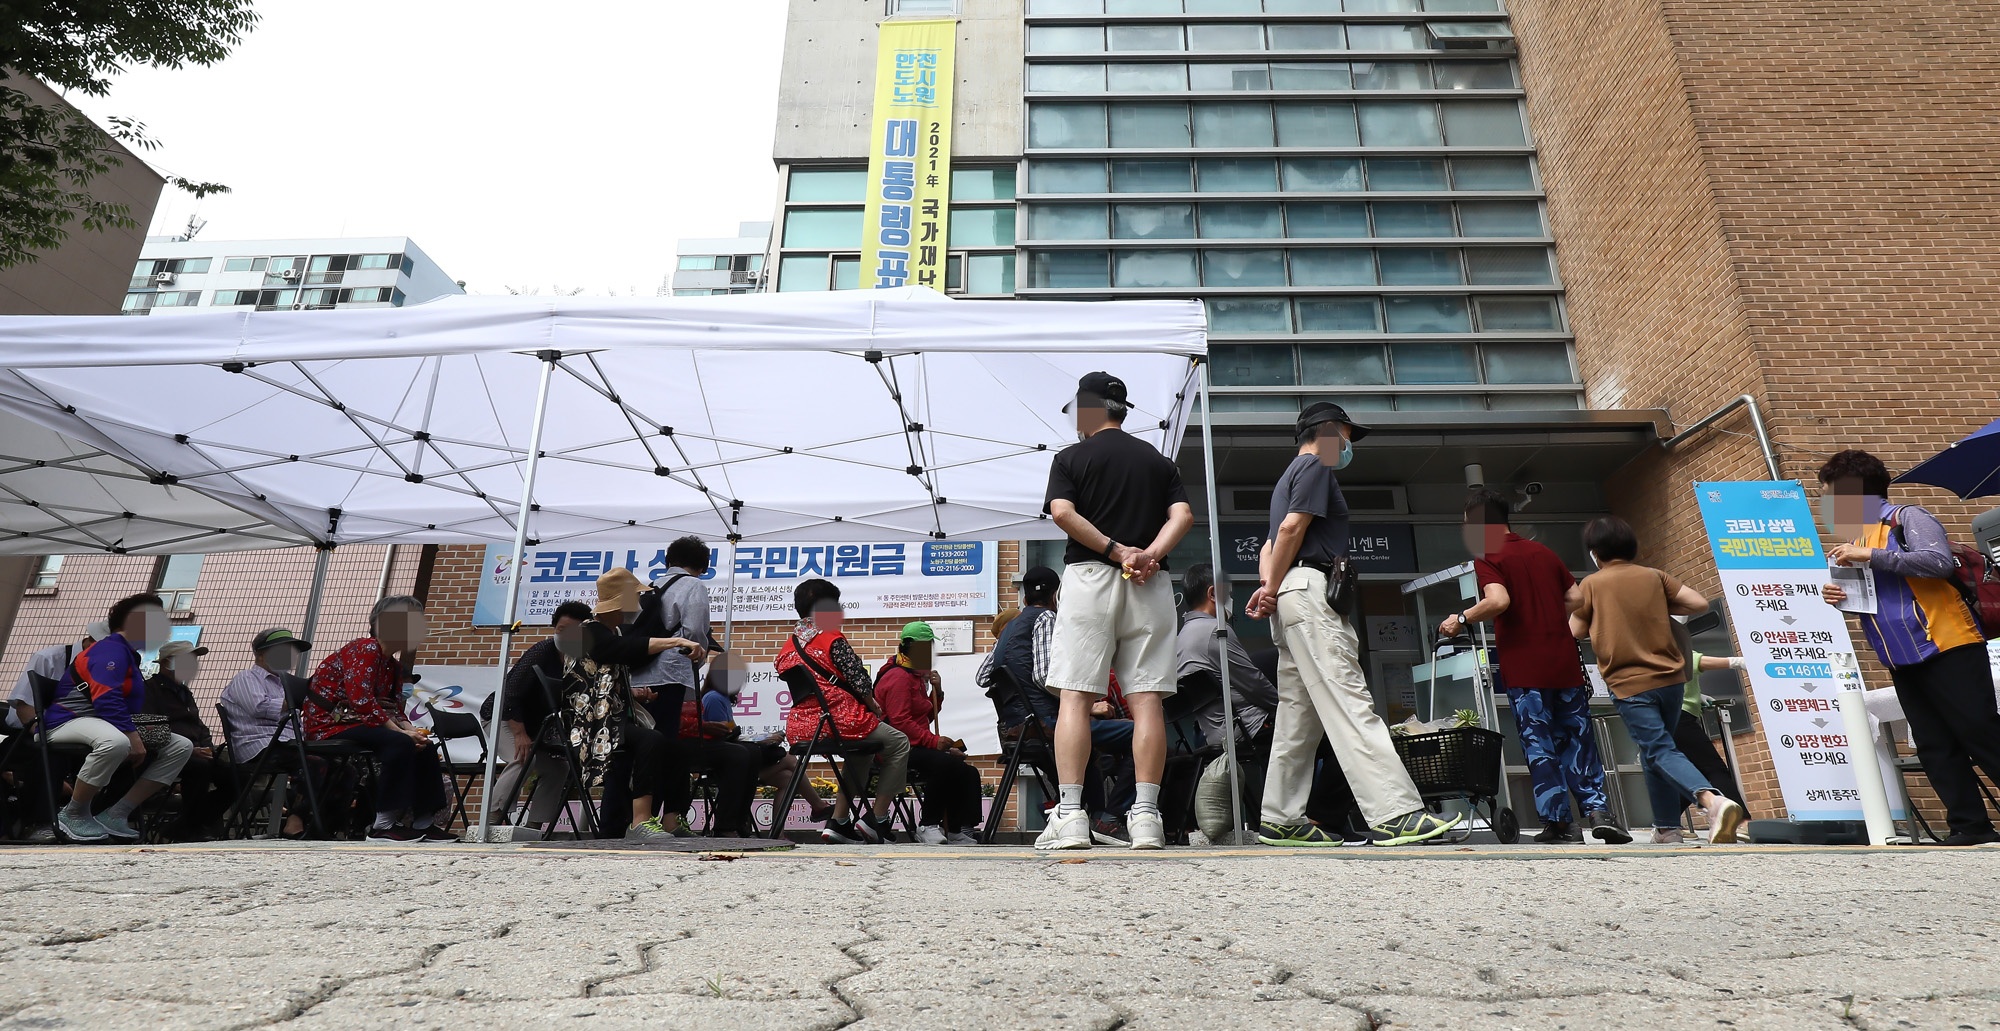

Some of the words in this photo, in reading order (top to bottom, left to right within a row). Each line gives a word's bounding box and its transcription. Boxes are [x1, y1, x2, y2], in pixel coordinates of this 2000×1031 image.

[1724, 519, 1766, 534] 코로나
[1767, 518, 1796, 533] 상생
[1718, 537, 1815, 557] 국민지원금신청
[530, 549, 639, 583] 코로나
[733, 543, 906, 579] 국민지원금
[750, 586, 778, 594] 토스에서
[1751, 583, 1795, 596] 신분증을
[1795, 583, 1819, 596] 꺼내
[765, 603, 786, 611] 카드사
[839, 601, 860, 610] 6:00)
[1755, 599, 1789, 612] 주세요
[1764, 631, 1809, 644] 안심콜로
[1810, 630, 1833, 644] 전화
[1769, 647, 1793, 660] 걸어
[1794, 647, 1828, 660] 주세요
[1788, 665, 1832, 677] 146114
[1784, 698, 1830, 712] 발열체크
[1795, 734, 1820, 748] 입장
[1820, 734, 1849, 748] 번호
[1800, 752, 1849, 766] 받으세요
